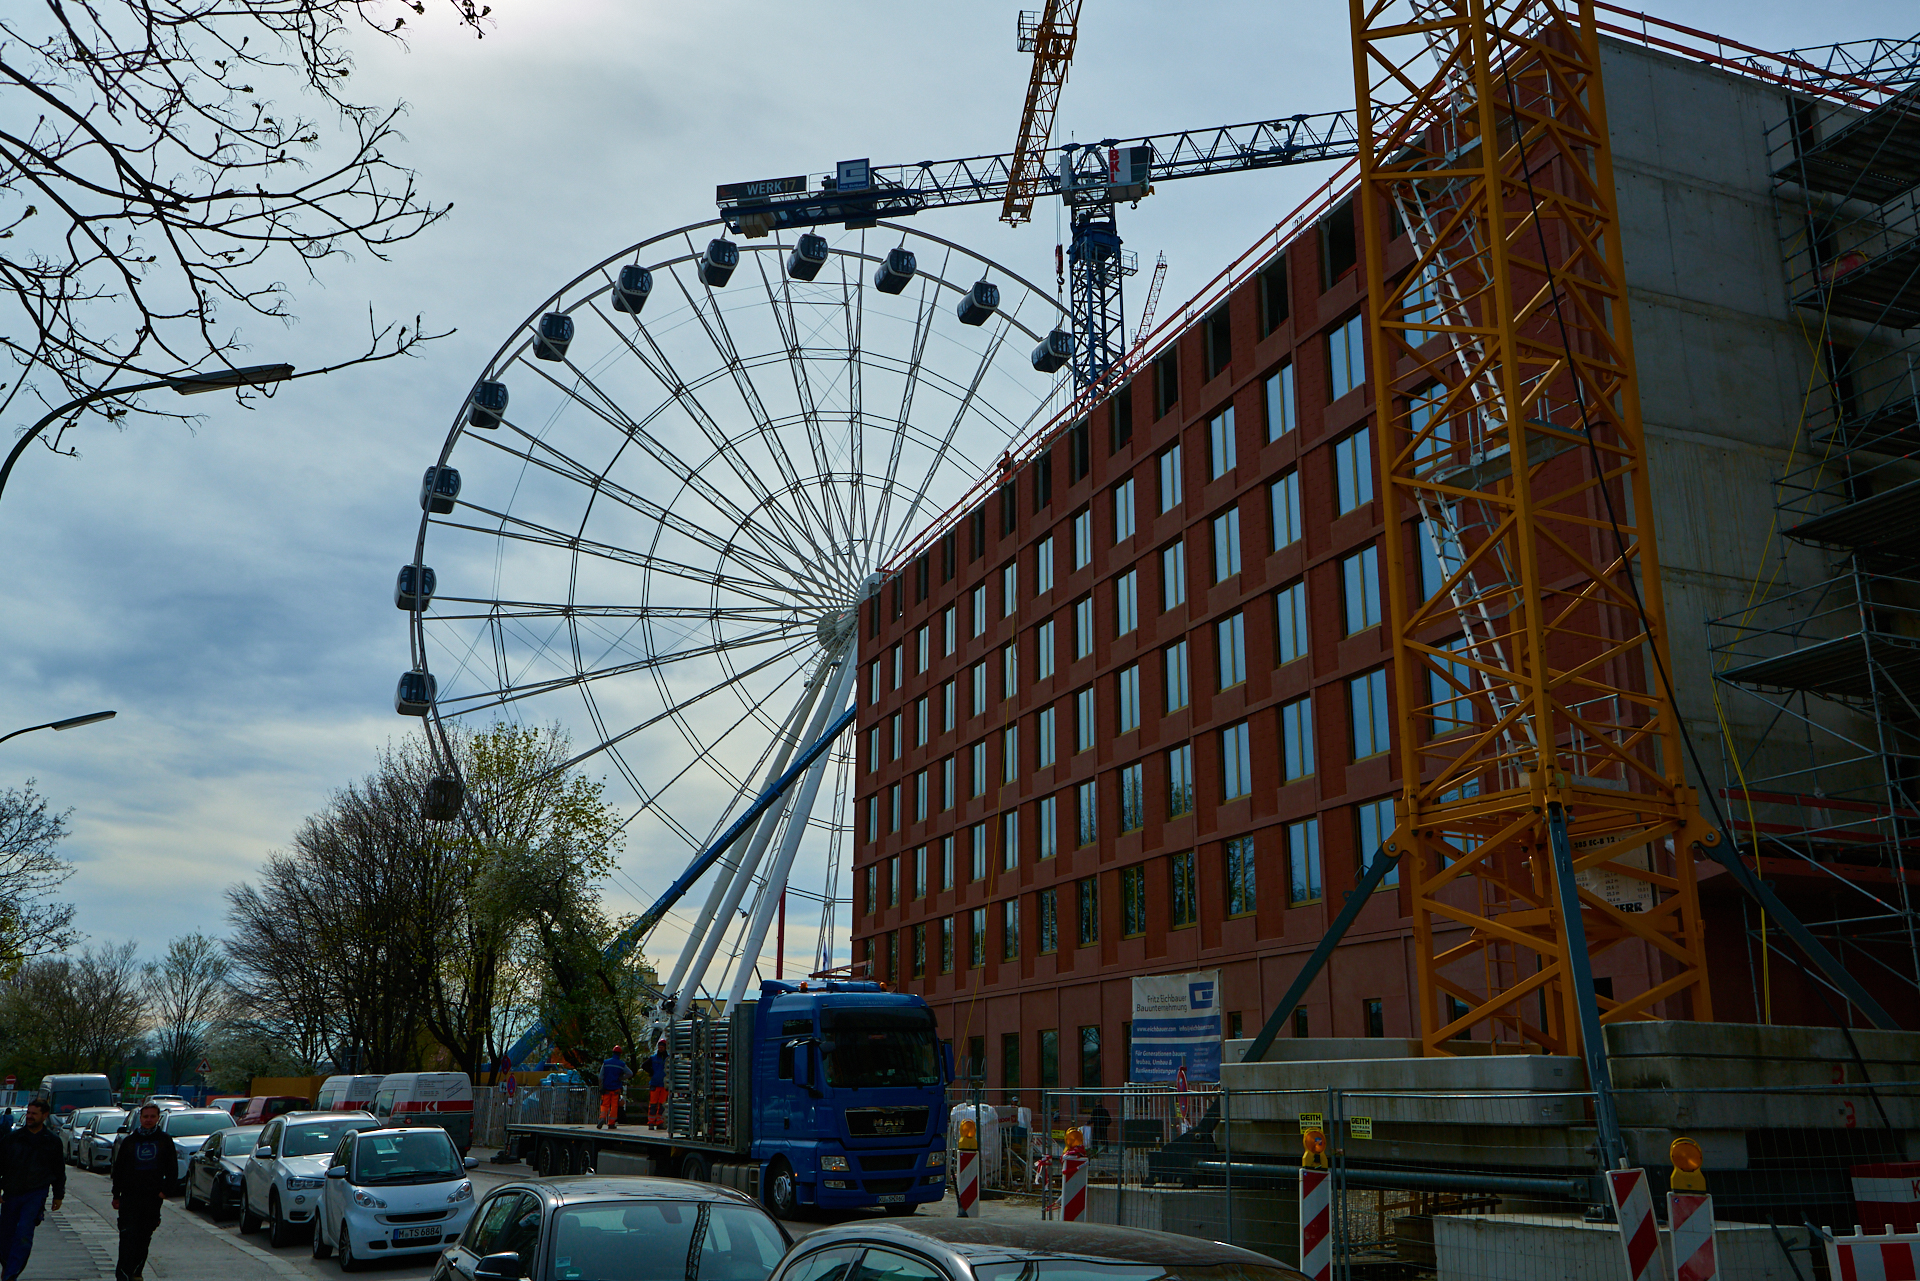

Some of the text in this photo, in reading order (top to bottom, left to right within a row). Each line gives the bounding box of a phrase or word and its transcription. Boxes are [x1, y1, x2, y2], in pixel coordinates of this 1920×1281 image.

[1109, 149, 1121, 183] BKL
[1147, 993, 1187, 1003] Fritz Eichbauer
[1136, 1003, 1188, 1013] Bauunternehmung
[872, 1117, 905, 1127] MAN
[1351, 1117, 1370, 1125] GEITH
